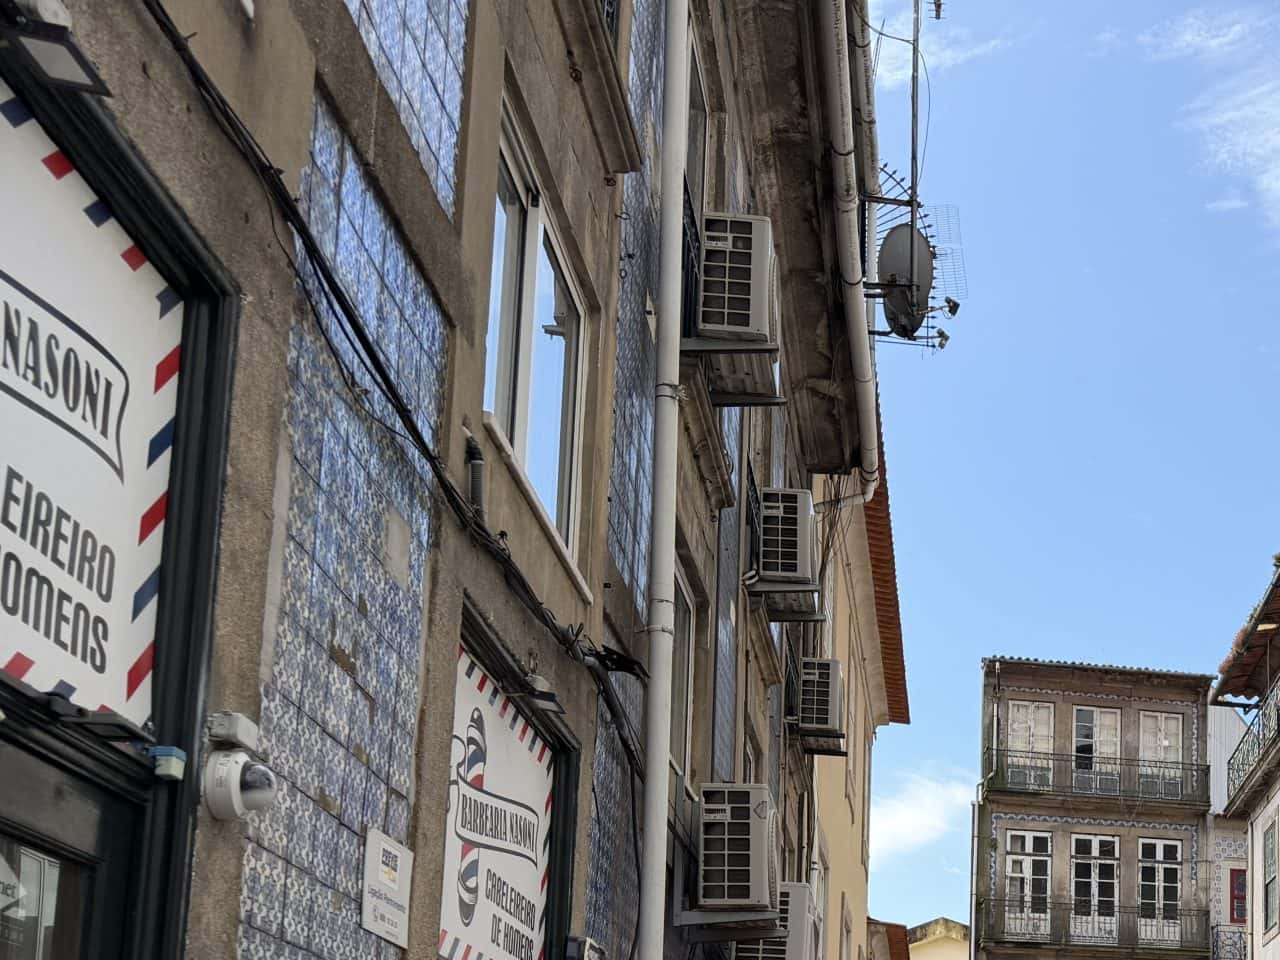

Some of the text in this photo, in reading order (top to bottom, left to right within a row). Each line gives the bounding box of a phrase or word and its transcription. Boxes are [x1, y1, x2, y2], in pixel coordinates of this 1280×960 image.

[2, 300, 113, 441] NASONI
[0, 464, 116, 604] EIREIRO
[0, 551, 109, 675] OMENS
[460, 793, 535, 852] BARBEARIA NASONI
[485, 868, 536, 932] CABELEIREIRO
[491, 913, 502, 947] DE
